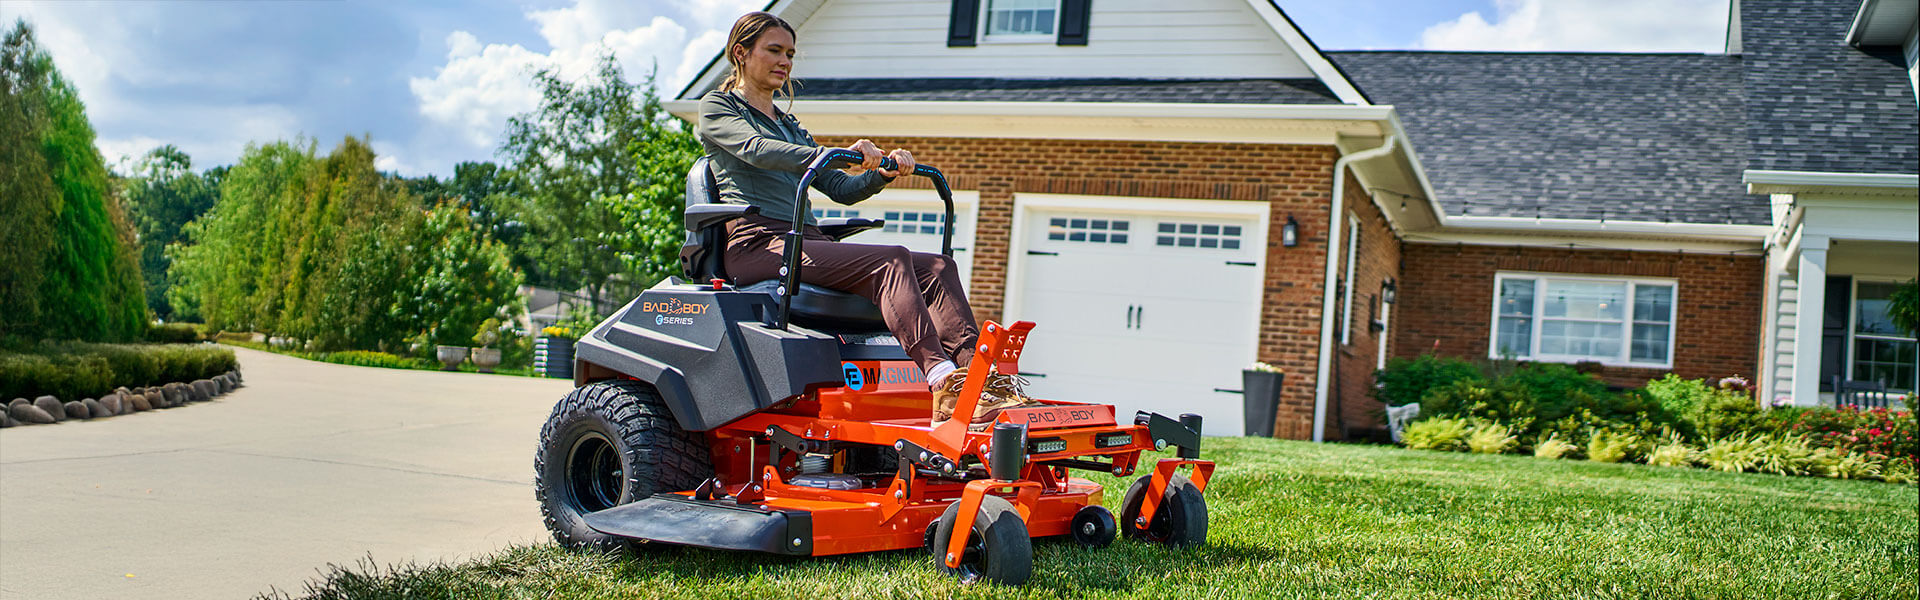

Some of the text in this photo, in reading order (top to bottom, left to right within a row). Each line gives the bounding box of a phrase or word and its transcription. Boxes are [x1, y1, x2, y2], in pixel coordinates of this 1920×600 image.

[643, 302, 710, 314] BAD BOY
[664, 316, 693, 325] SERIES
[863, 368, 926, 385] MAGNUM
[1027, 410, 1095, 423] BAD BOY
